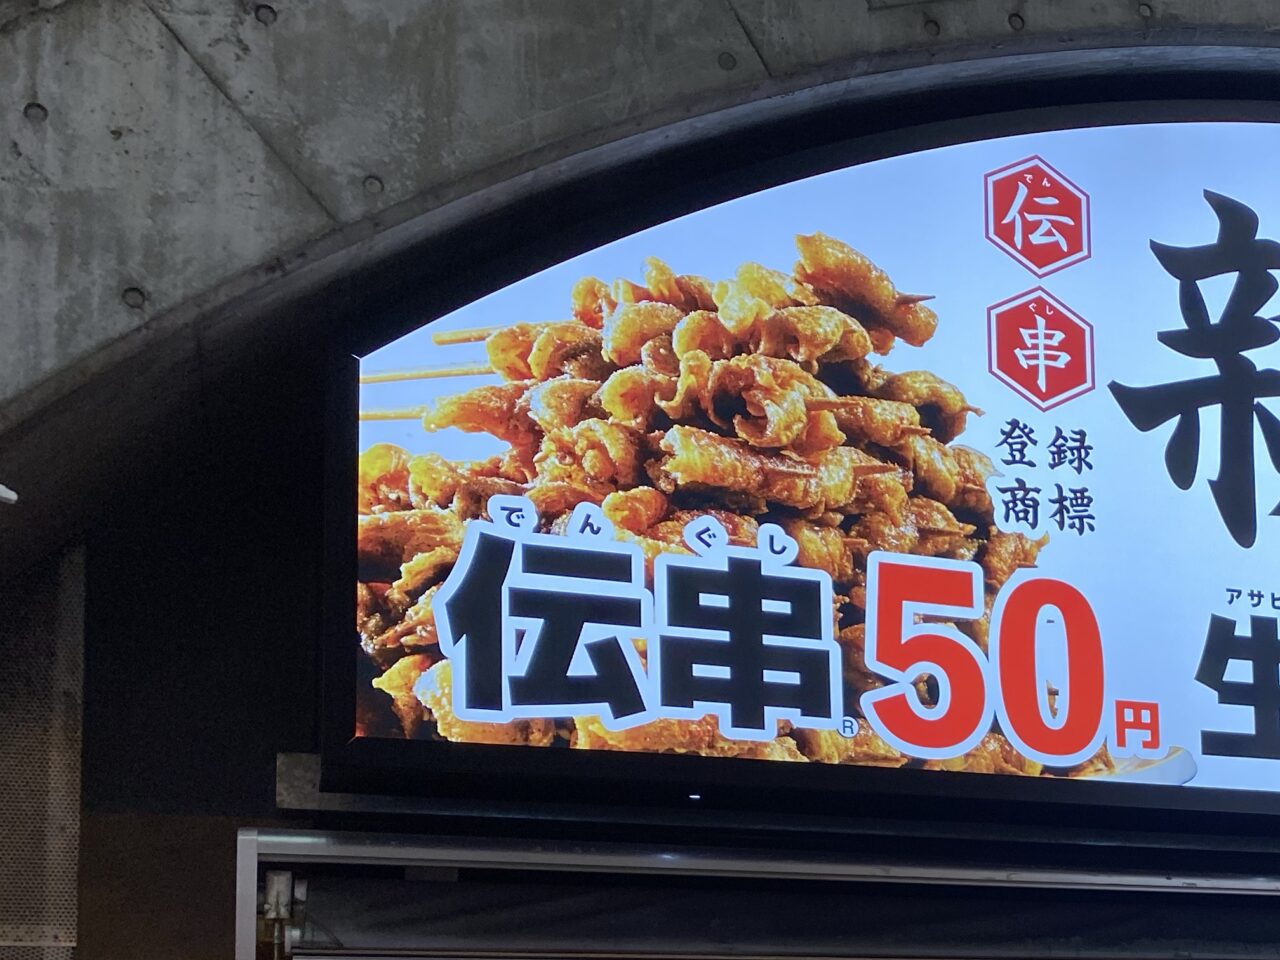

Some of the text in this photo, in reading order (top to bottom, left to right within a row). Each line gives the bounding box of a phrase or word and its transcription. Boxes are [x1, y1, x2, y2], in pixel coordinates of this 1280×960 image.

[1023, 173, 1051, 188] でん
[1000, 181, 1075, 253] 伝
[1013, 313, 1072, 393] 串
[994, 417, 1094, 476] 登録
[995, 477, 1096, 536] 商標
[444, 531, 835, 731] 伝串
